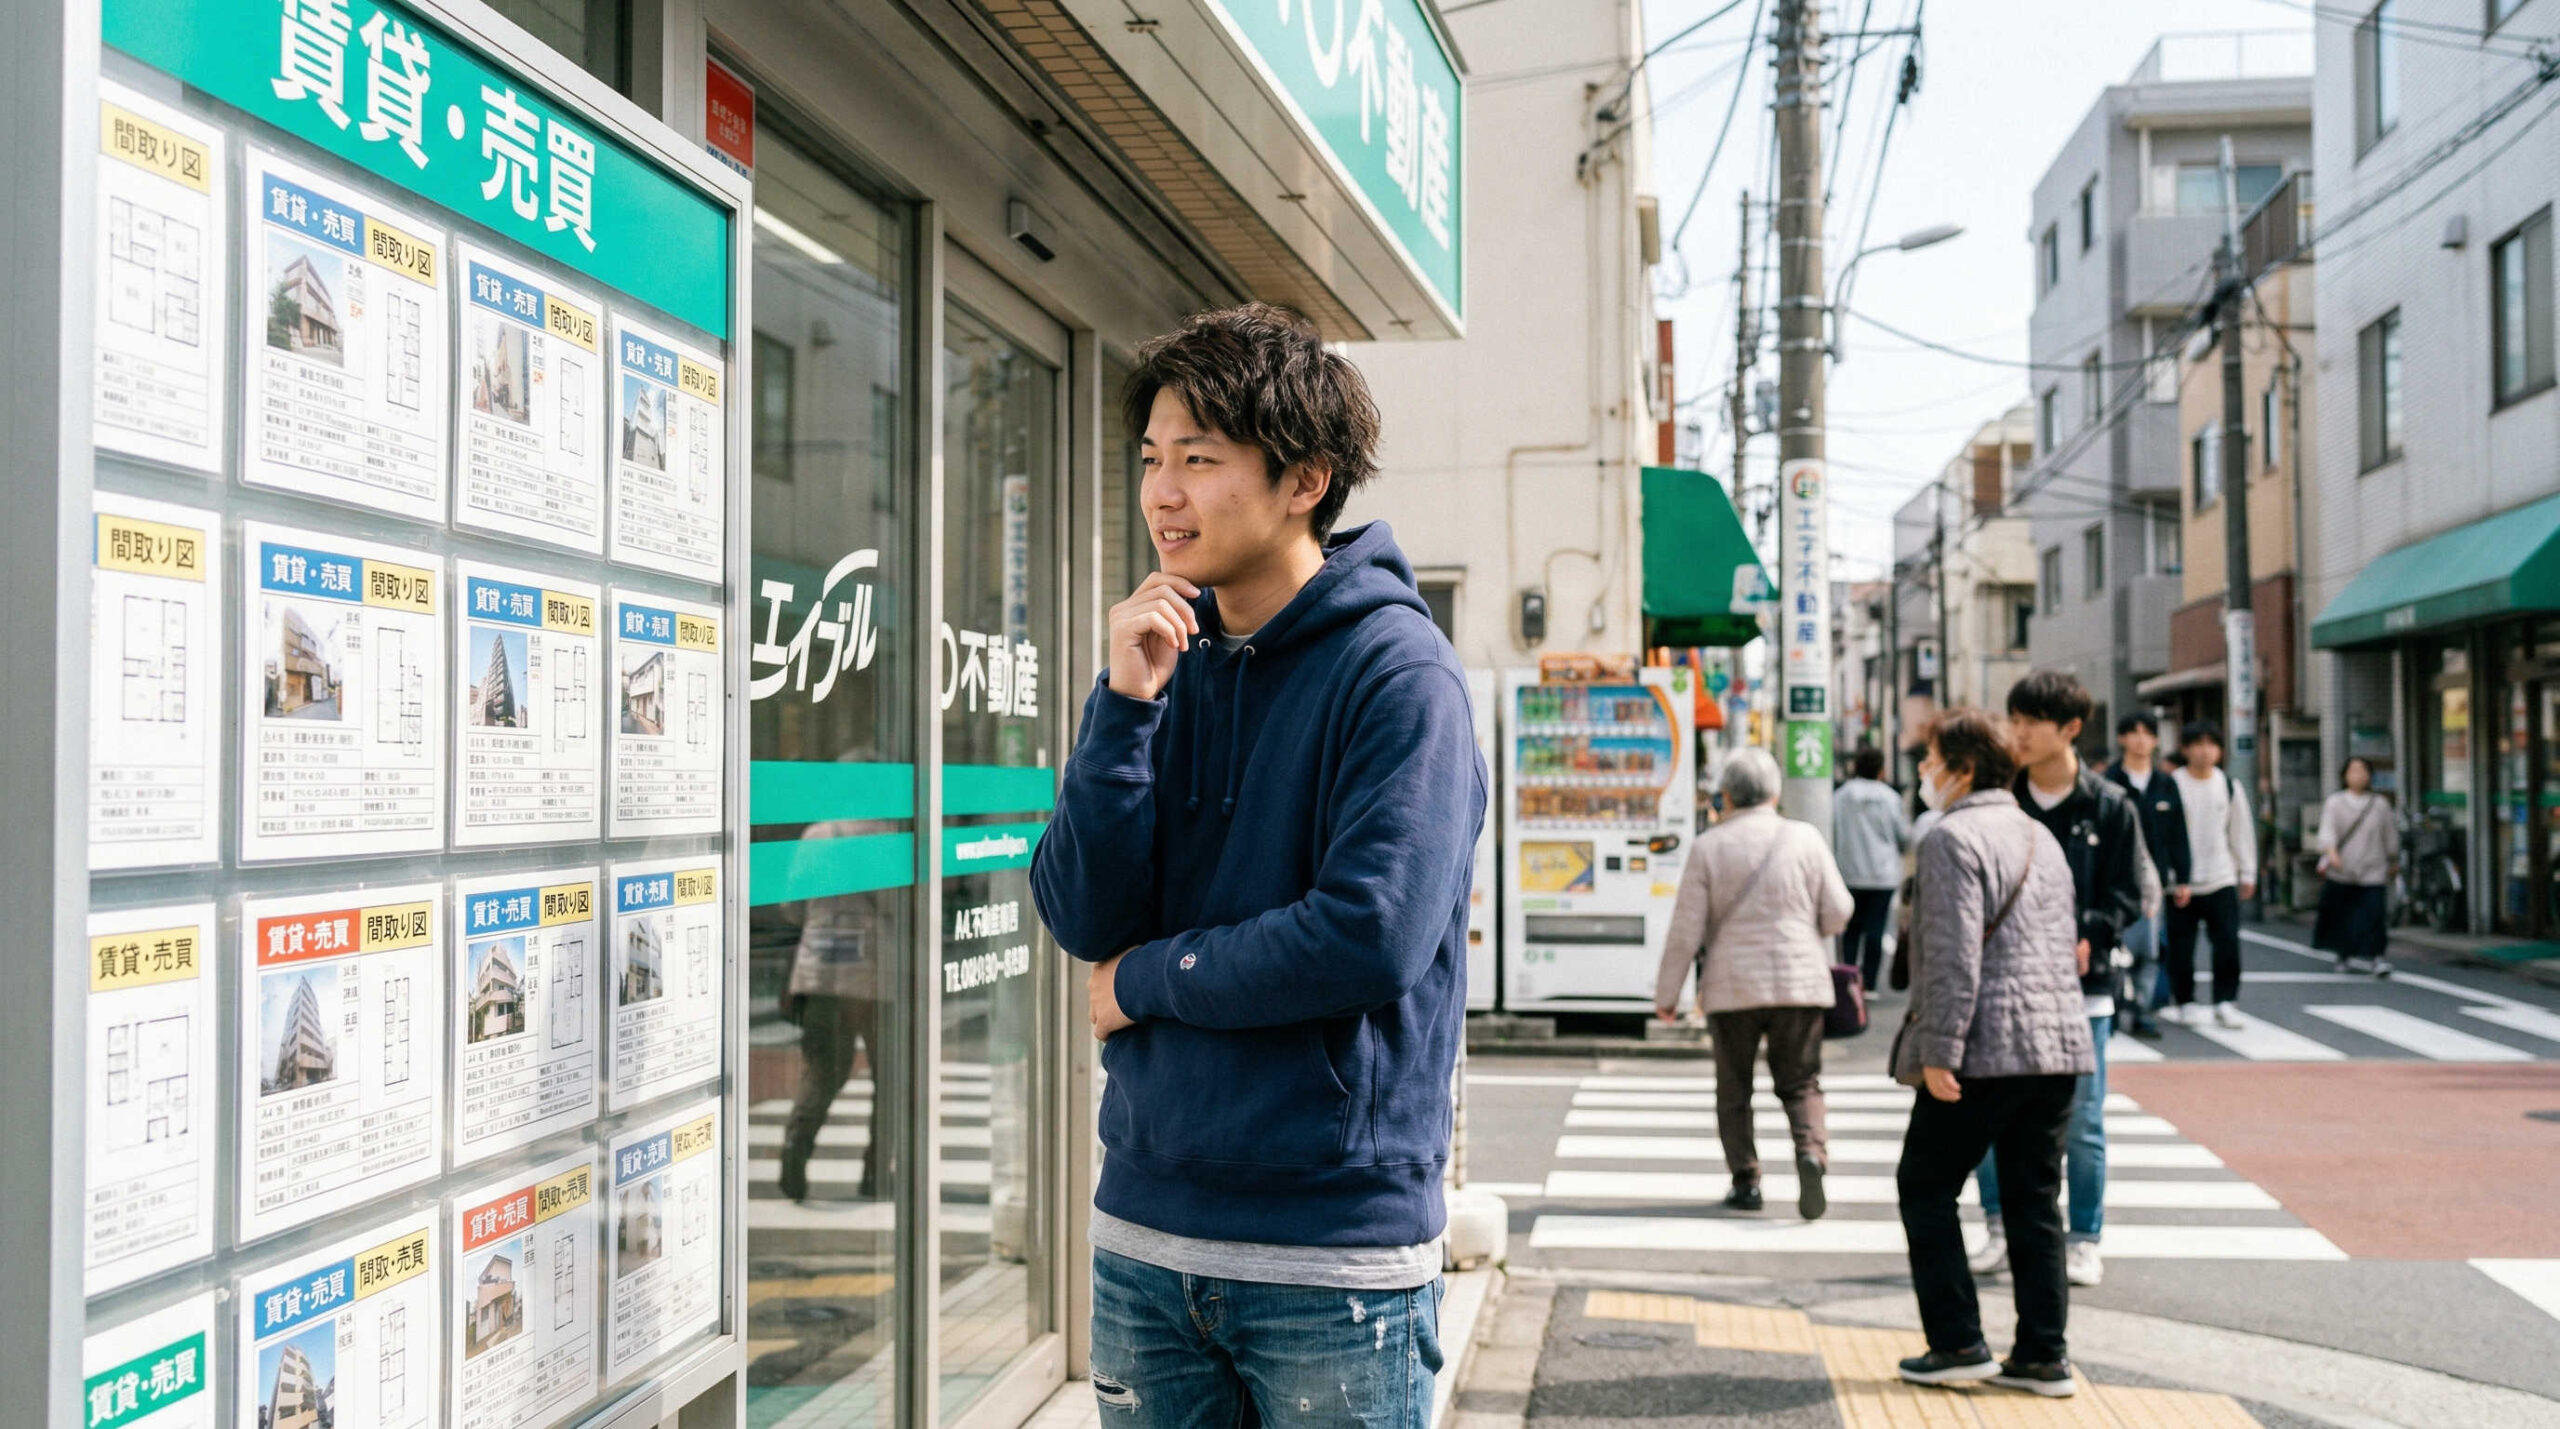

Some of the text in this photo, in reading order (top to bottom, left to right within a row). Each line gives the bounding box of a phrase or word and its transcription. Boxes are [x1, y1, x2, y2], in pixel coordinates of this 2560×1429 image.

[114, 117, 201, 181] 間取り図
[270, 0, 597, 253] 賃貸・売買
[270, 186, 431, 278] 賃貸・売買 間取り図
[111, 528, 194, 569] 間取り図
[272, 553, 429, 605] 賃貸・売買 間取り図
[475, 586, 590, 628] 賃貸・売買 間取り図
[751, 549, 878, 703] エイブル
[267, 911, 427, 957] 賃貸・売買 間取り図
[473, 890, 589, 928] 賃貸・売買 間取り図
[98, 938, 192, 980] 賃貸・売買
[470, 1195, 528, 1242] 賃貸・売買
[264, 1239, 424, 1329] 賃貸・売買 間取・売買
[88, 1347, 196, 1428] 賃貸・売買
